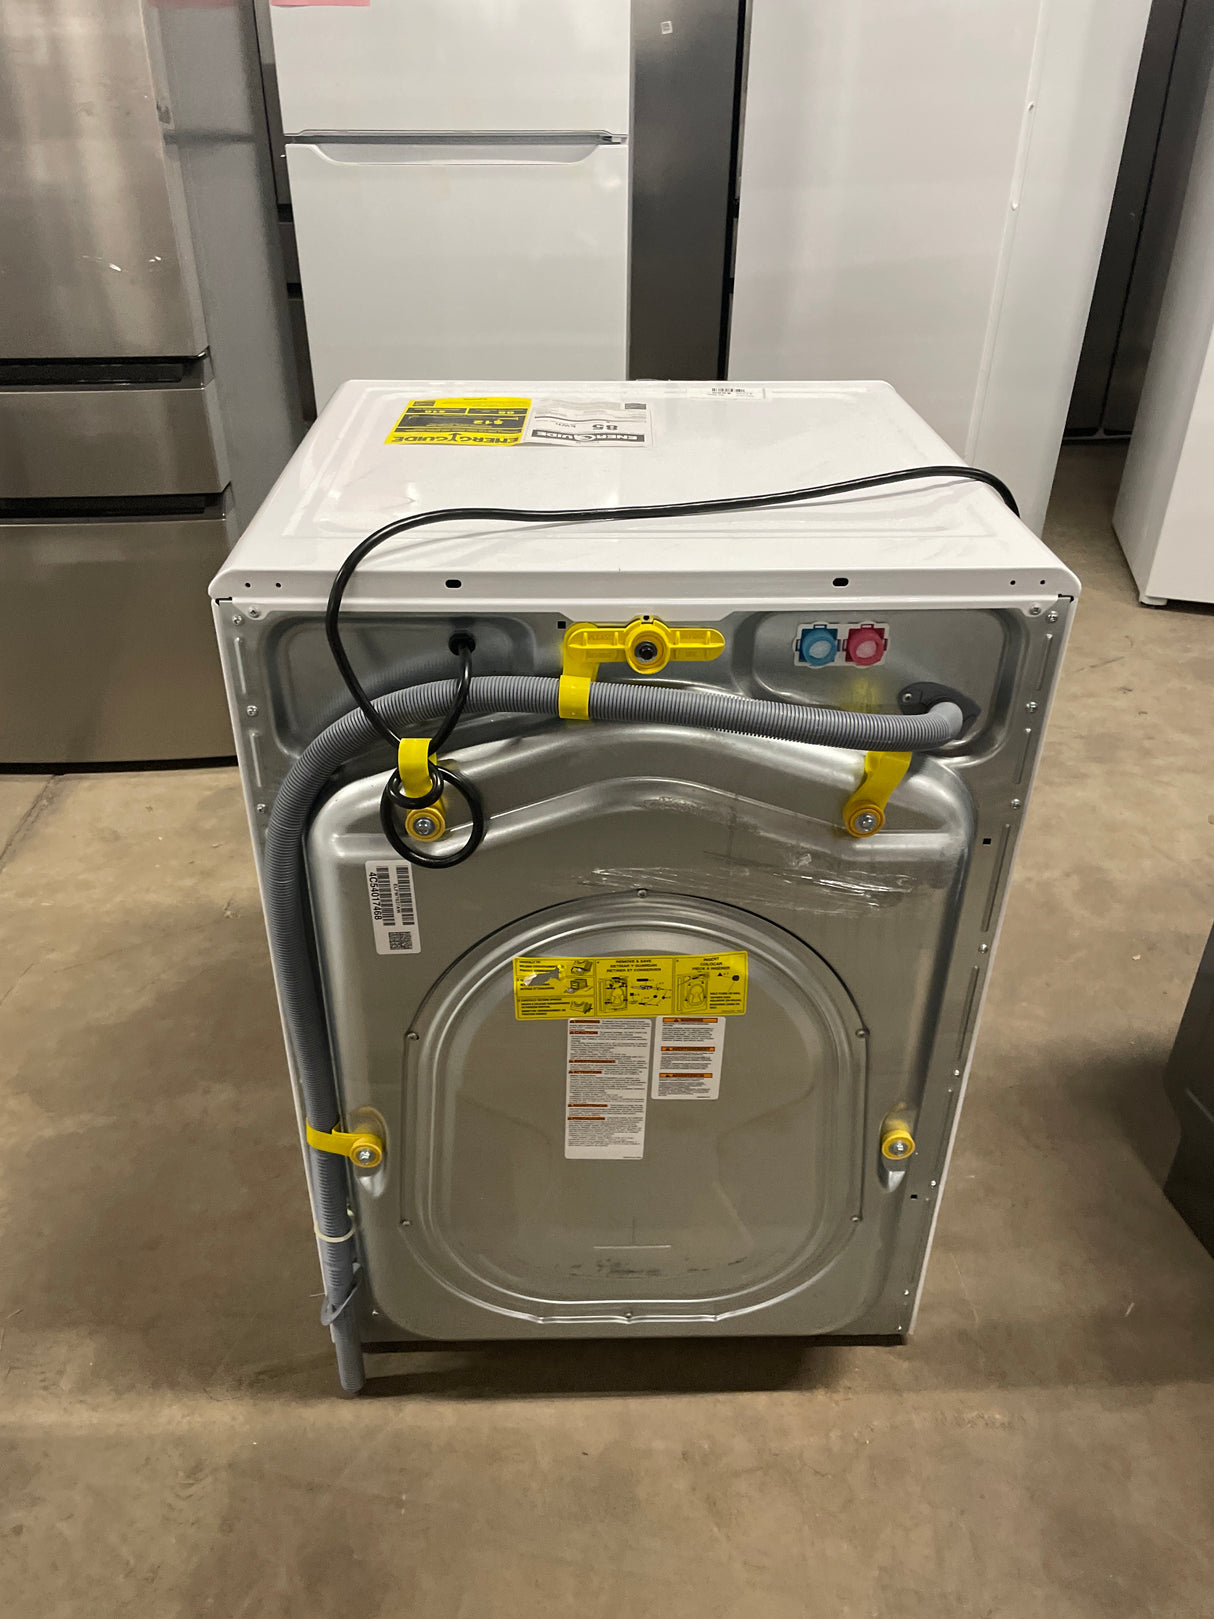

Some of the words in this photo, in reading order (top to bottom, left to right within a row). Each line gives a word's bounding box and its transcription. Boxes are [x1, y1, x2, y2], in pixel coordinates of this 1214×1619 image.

[592, 423, 618, 431] 85
[392, 432, 519, 443] ENERGYGUIDE
[368, 872, 383, 920] 4C54017468
